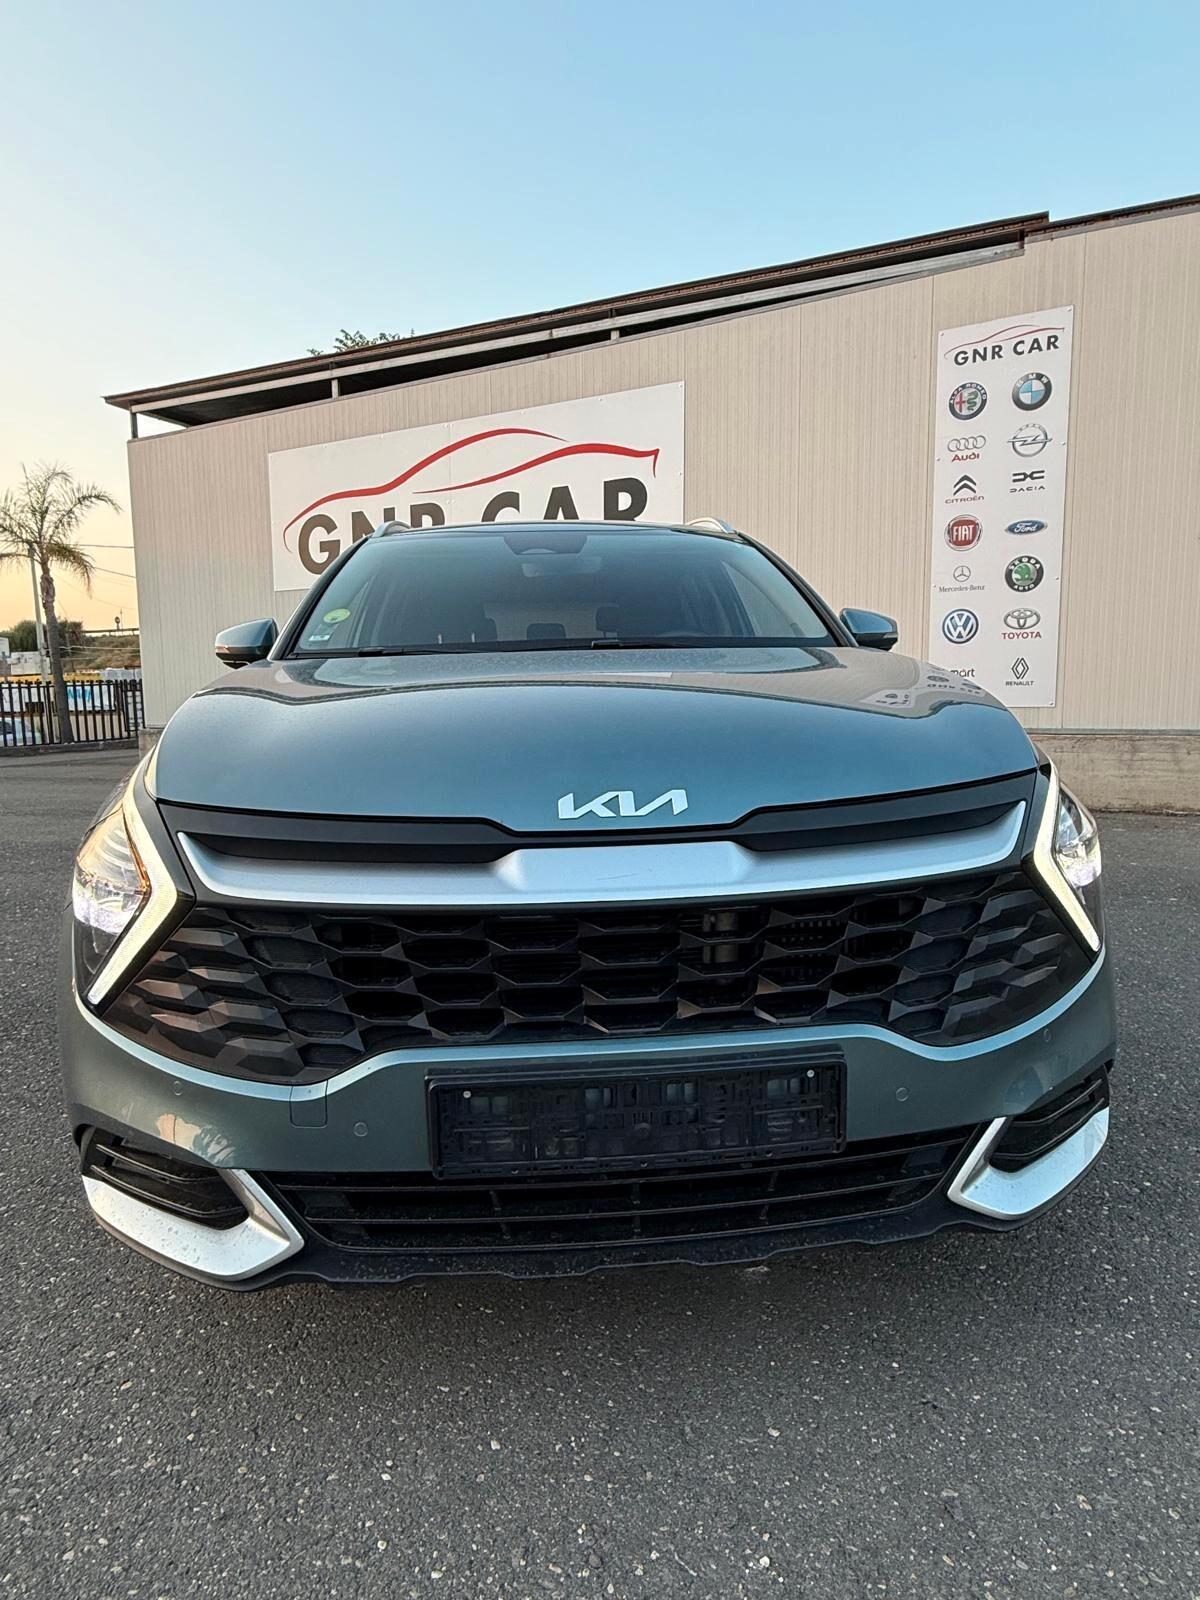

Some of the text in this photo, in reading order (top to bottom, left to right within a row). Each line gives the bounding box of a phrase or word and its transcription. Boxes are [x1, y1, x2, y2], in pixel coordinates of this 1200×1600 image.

[954, 335, 1059, 366] GNR CAR
[1009, 485, 1046, 494] DACIA
[1014, 522, 1038, 533] Ford
[953, 525, 975, 542] FIAT
[1013, 583, 1035, 591] AUTO
[1001, 631, 1042, 640] TOYOTA
[950, 668, 976, 677] mart
